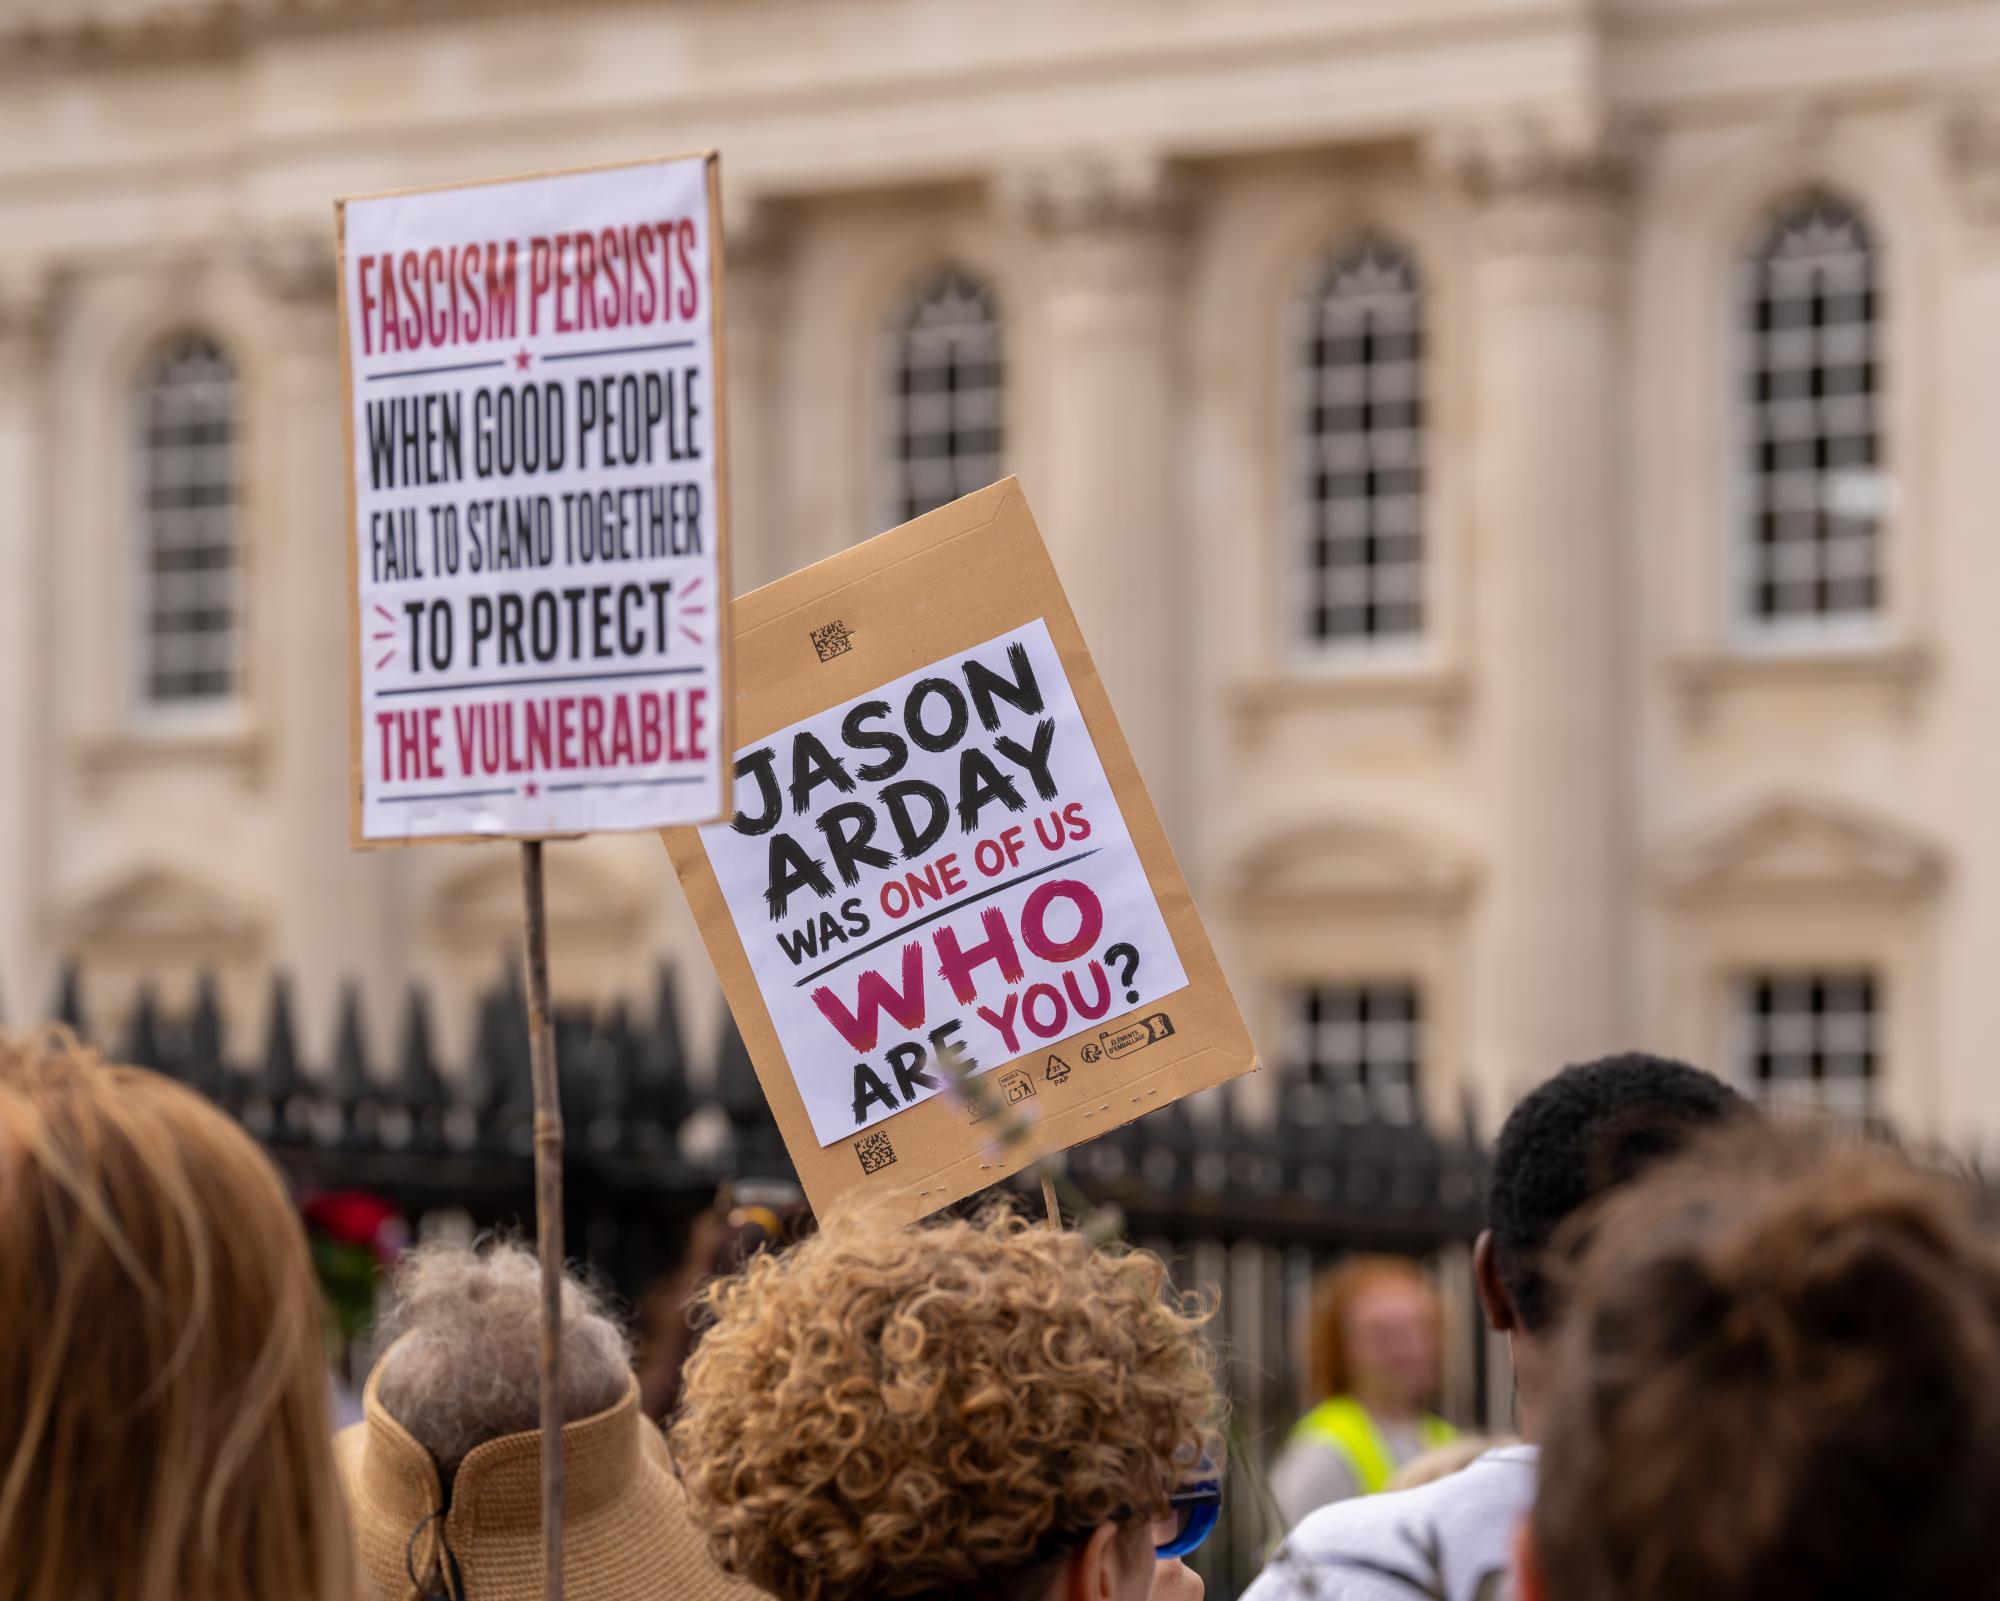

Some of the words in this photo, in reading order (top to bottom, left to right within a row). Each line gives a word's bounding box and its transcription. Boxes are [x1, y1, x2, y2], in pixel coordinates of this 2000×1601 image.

[358, 241, 517, 356] FASCISM
[529, 216, 698, 337] PERSISTS
[366, 389, 462, 490] WHEN
[473, 381, 565, 477] GOOD
[578, 367, 701, 468] PEOPLE
[371, 507, 423, 583] FAIL
[429, 503, 460, 576] TO
[468, 496, 554, 573] STAND
[560, 482, 702, 567] TOGETHER
[404, 598, 453, 673] TO
[469, 580, 671, 668] PROTECT
[377, 707, 443, 783] THE
[454, 688, 707, 776] VULNERABLE
[730, 641, 1044, 835] JASON
[764, 717, 1057, 921] ARDAY
[775, 897, 870, 966] WAS
[879, 853, 969, 920] ONE
[975, 824, 1027, 876] OF
[1033, 802, 1092, 851] US
[811, 879, 1104, 1054] WHO
[850, 1019, 978, 1126] ARE
[977, 942, 1141, 1054] YOU?
[1052, 1065, 1061, 1073] 21
[1054, 1075, 1069, 1086] PAP
